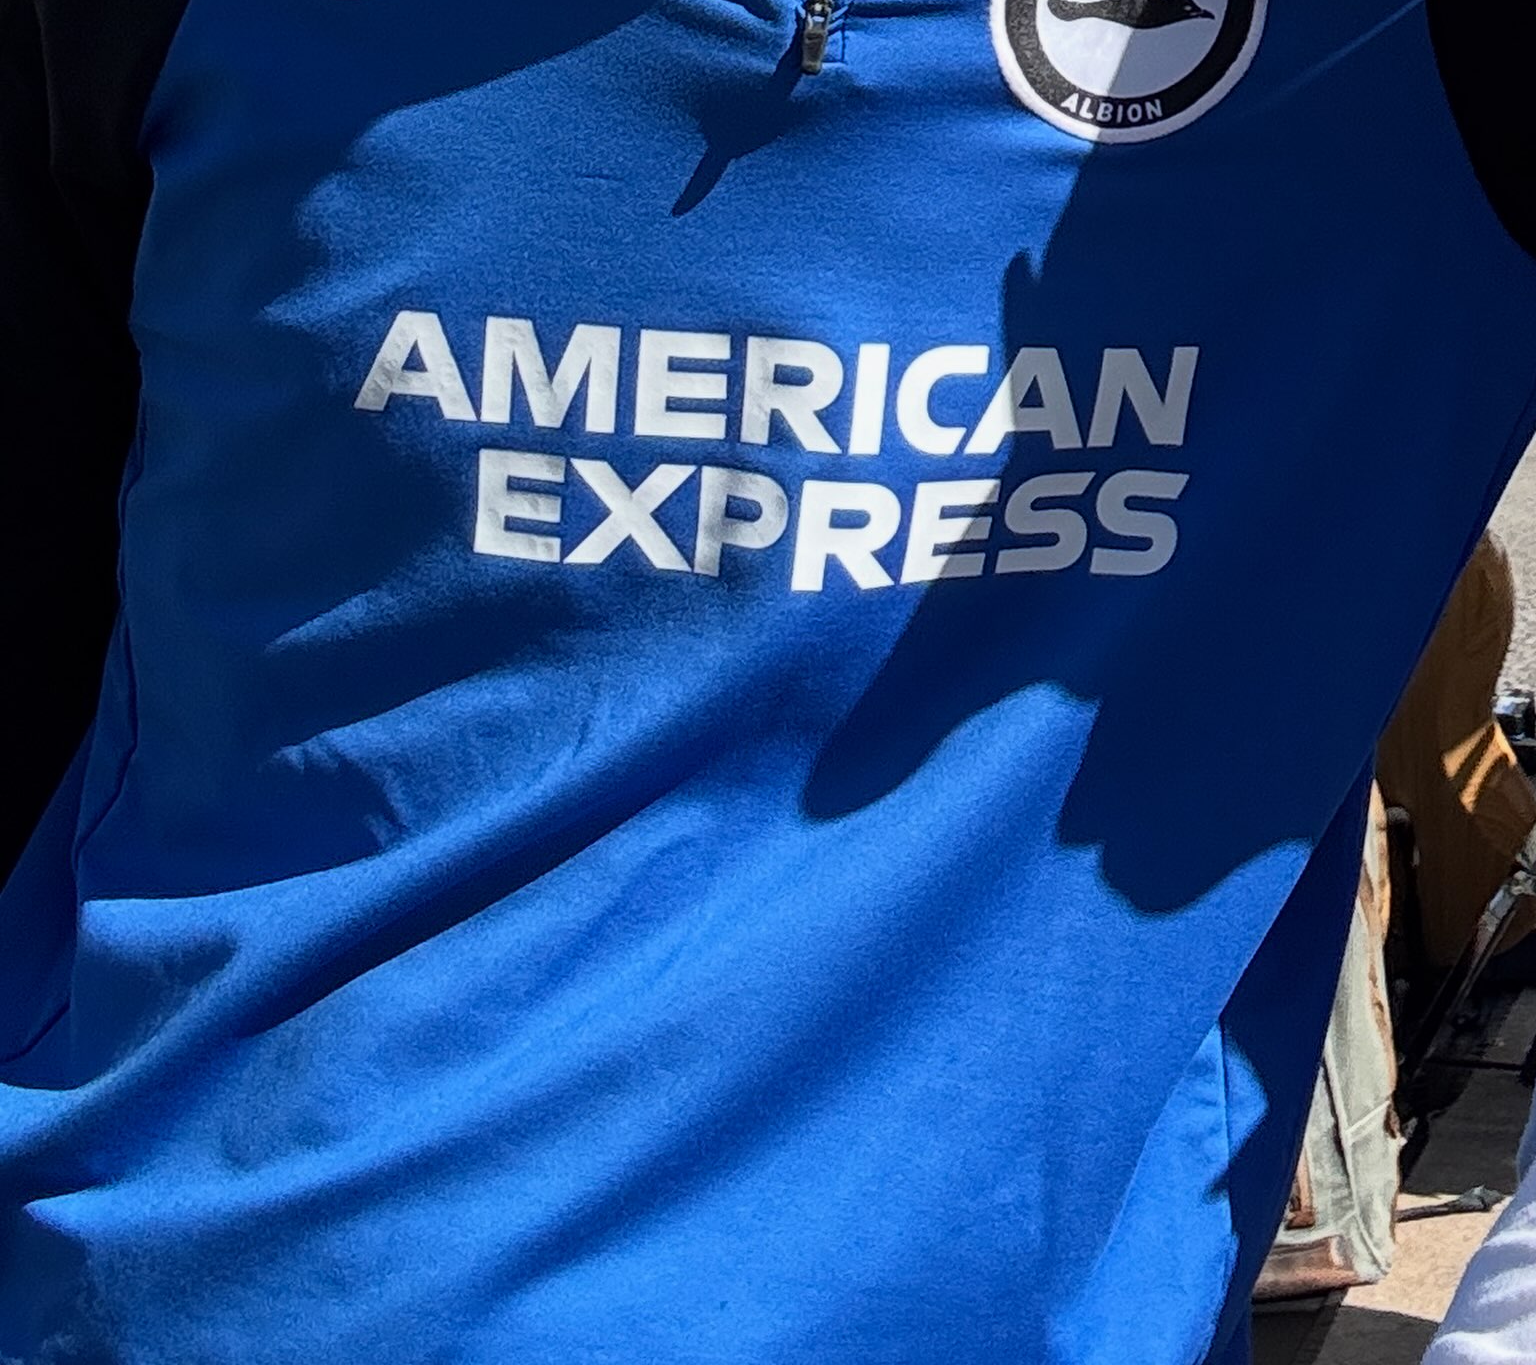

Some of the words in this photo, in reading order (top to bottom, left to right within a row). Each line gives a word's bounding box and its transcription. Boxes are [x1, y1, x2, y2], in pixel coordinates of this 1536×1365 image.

[1061, 92, 1163, 123] ALBION
[353, 310, 1200, 456] AMERICAN
[473, 448, 1190, 592] EXPRESS
